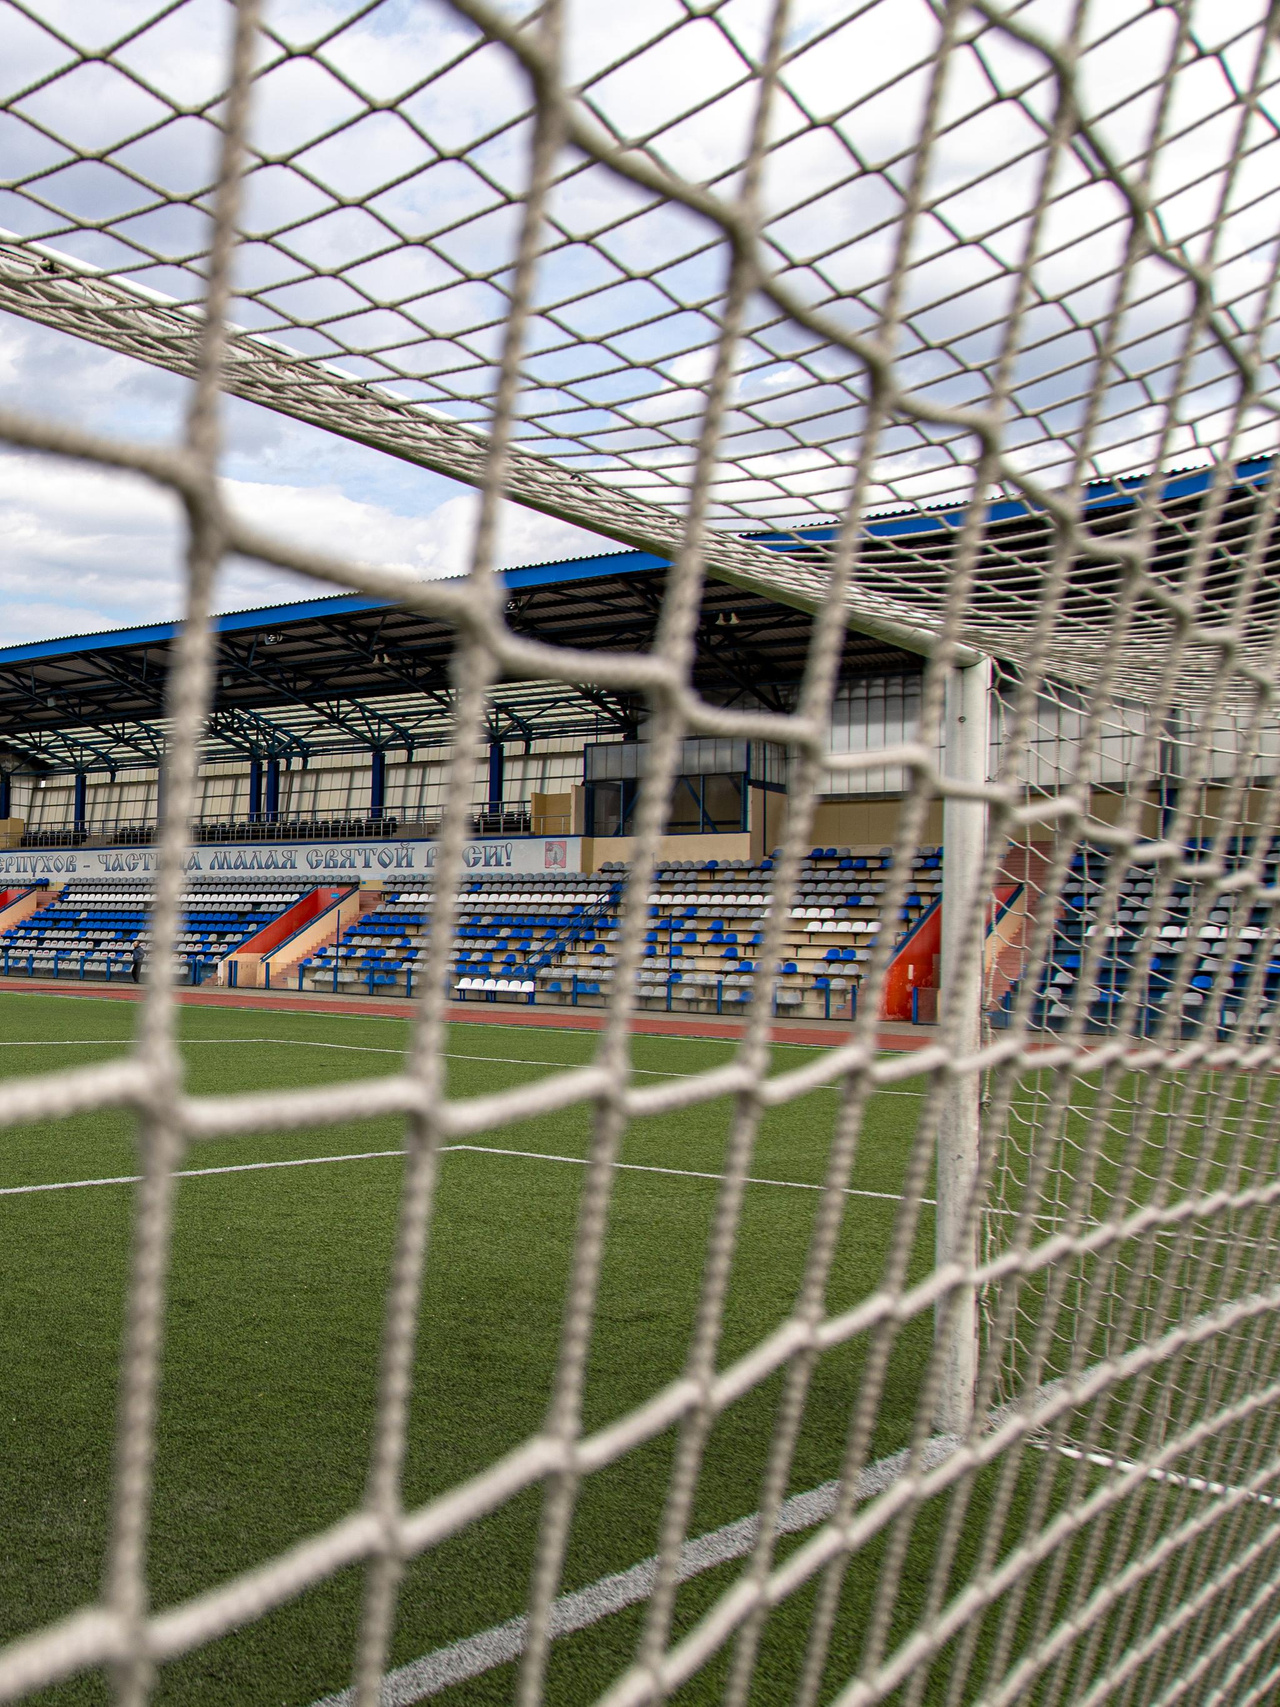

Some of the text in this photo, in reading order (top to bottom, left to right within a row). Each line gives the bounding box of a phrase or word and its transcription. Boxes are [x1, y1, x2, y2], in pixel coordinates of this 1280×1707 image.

[209, 849, 299, 870] МАЛАЯ
[306, 842, 416, 870] СВЯТОЙ
[424, 842, 513, 868] РСИ!
